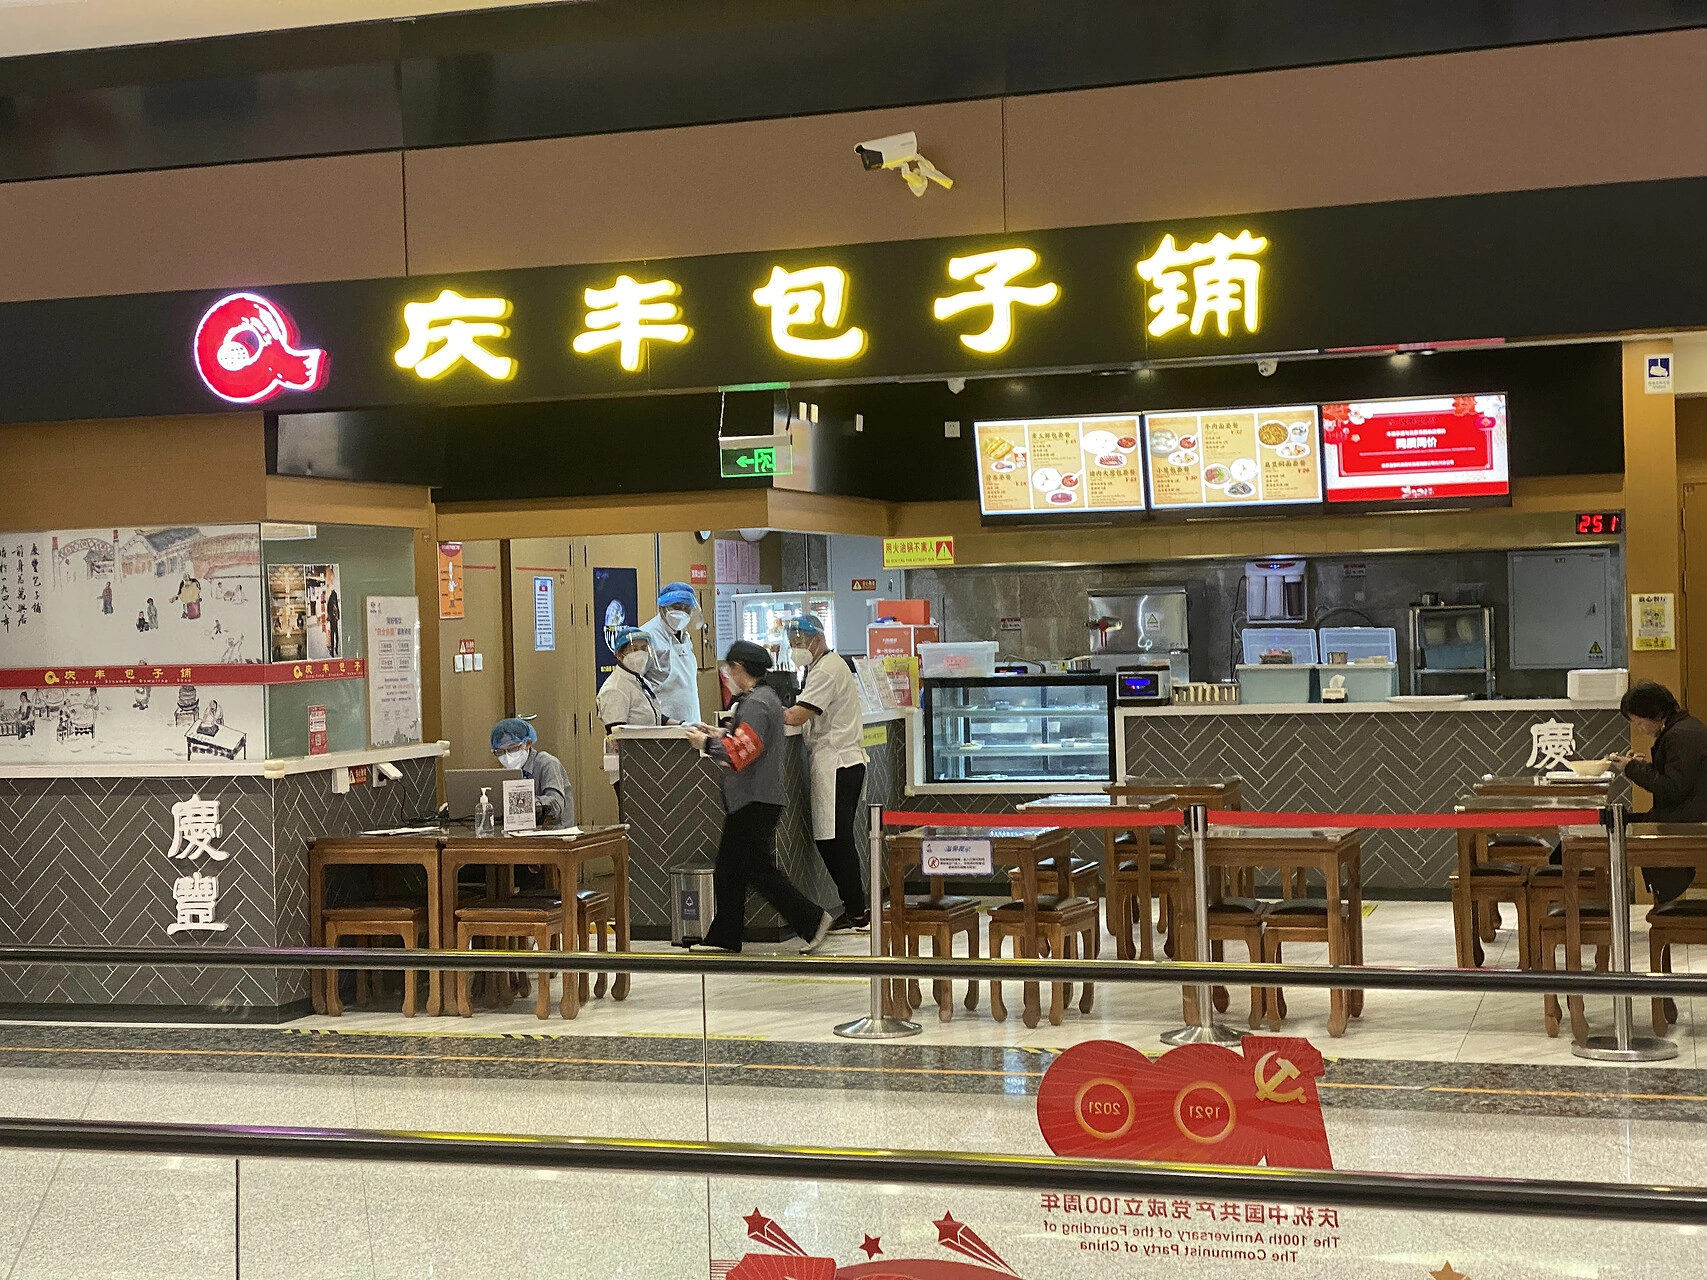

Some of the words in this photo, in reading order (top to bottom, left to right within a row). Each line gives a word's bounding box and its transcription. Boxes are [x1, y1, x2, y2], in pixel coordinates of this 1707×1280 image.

[394, 229, 1268, 380] 庆丰包子铺
[64, 668, 192, 680] 庆丰包子铺
